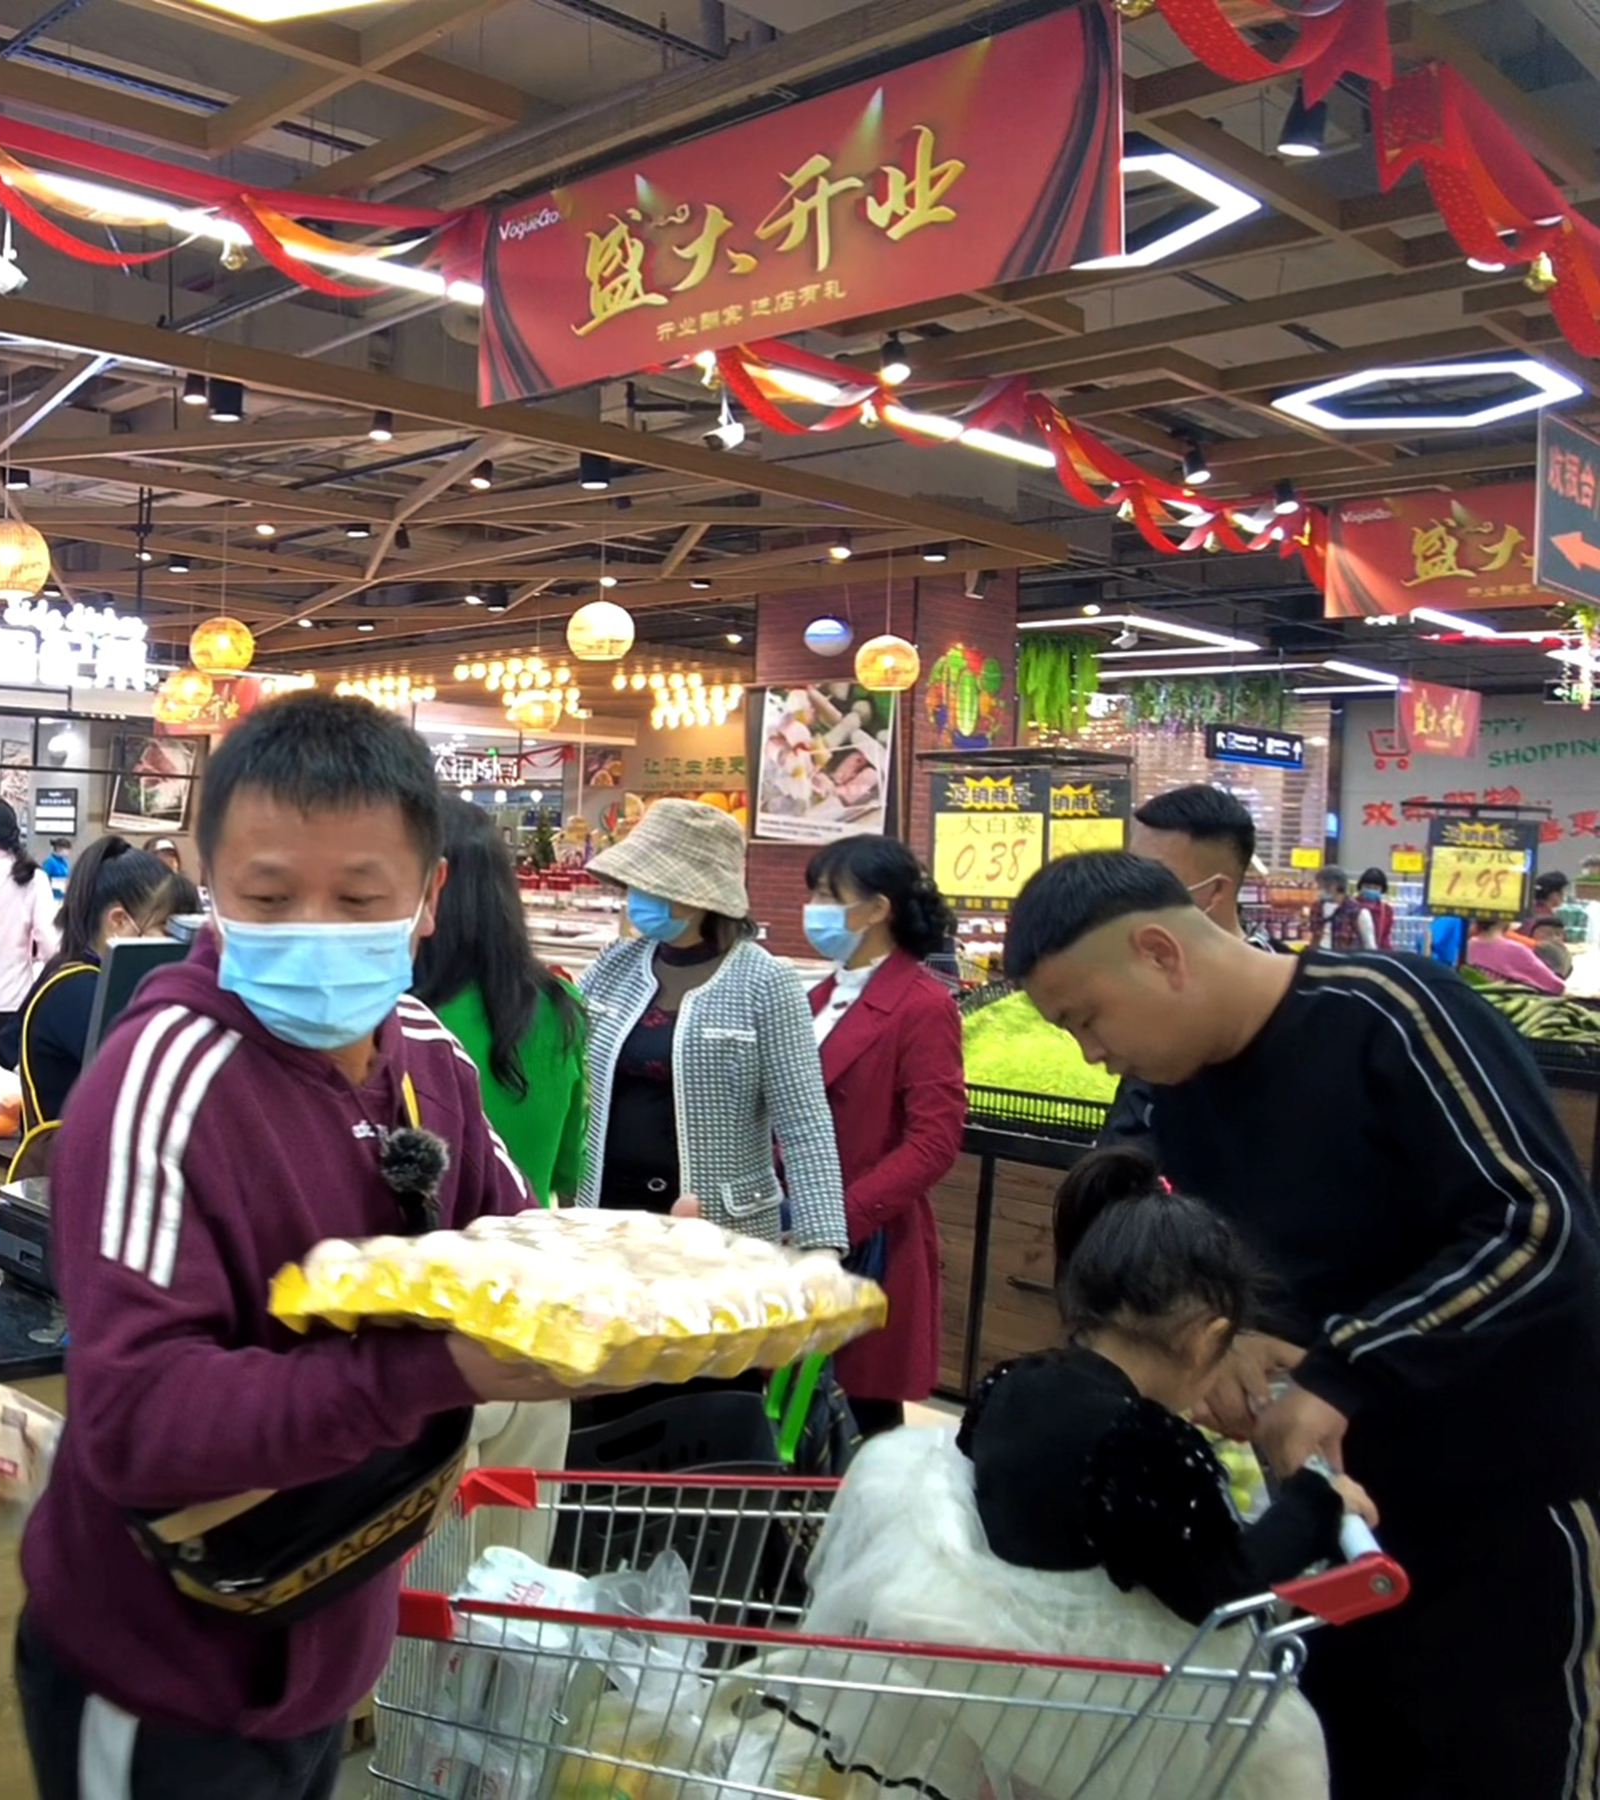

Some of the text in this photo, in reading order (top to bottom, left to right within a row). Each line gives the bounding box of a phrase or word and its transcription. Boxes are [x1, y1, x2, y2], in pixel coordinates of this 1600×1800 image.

[498, 207, 560, 241] VogueGo
[571, 124, 966, 338] 盛大开业
[751, 279, 847, 318] 进店有礼
[1488, 738, 1600, 768] SHOPPIN
[960, 816, 1036, 836] 大白菜
[954, 838, 1028, 882] 0.38
